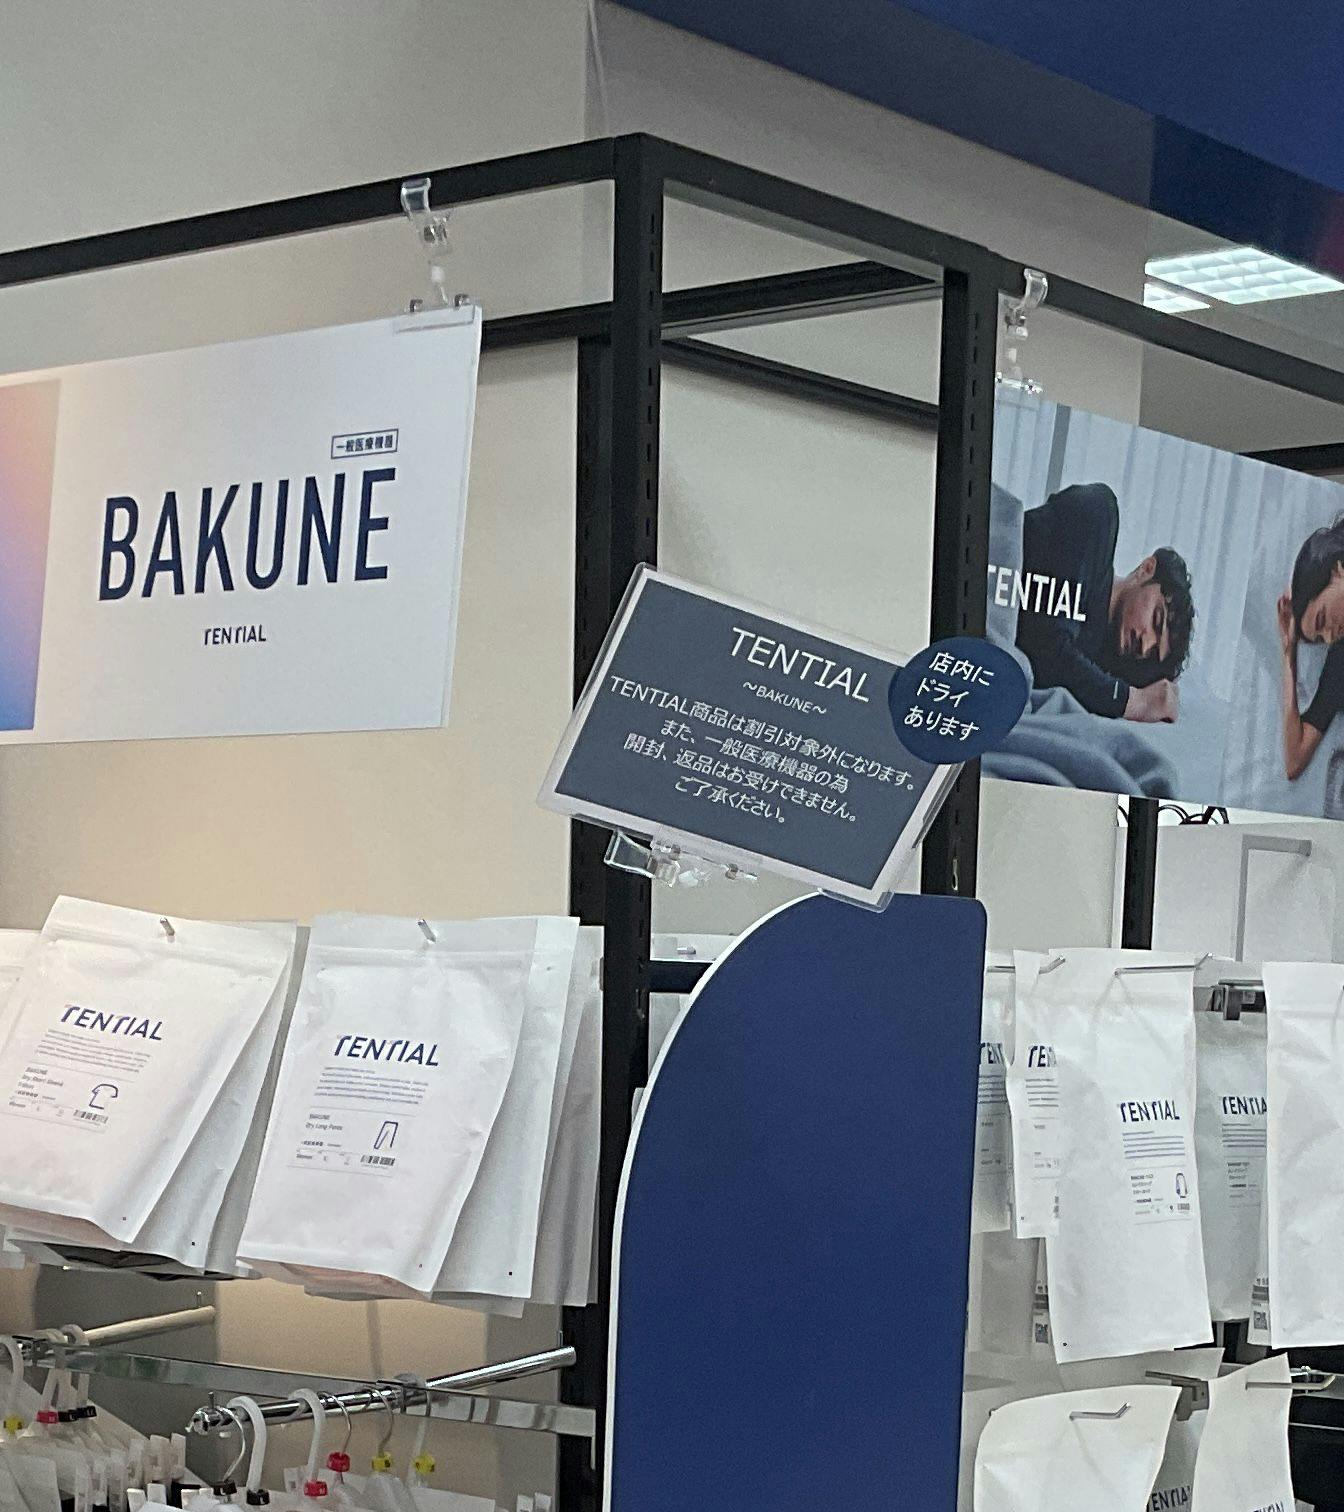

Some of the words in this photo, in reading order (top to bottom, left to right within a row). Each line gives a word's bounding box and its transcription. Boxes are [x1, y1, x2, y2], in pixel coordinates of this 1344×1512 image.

[98, 467, 397, 602] BAKUNE
[203, 624, 267, 646] TENTIAL
[730, 627, 870, 702] TENTIAL
[929, 652, 995, 686] 店内に
[916, 677, 970, 708] ドライ
[609, 675, 914, 790] TENTIAL商品は割引対象外になります。
[904, 705, 980, 741] あります
[661, 719, 848, 793] また、一般医療機器の為
[624, 733, 855, 822] 開封、返品はお受けできません。
[675, 775, 785, 823] ご了承ください。
[59, 1004, 163, 1041] TENTIAL
[334, 1035, 438, 1066] TENTIAL
[1119, 1100, 1180, 1123] TENTIAL
